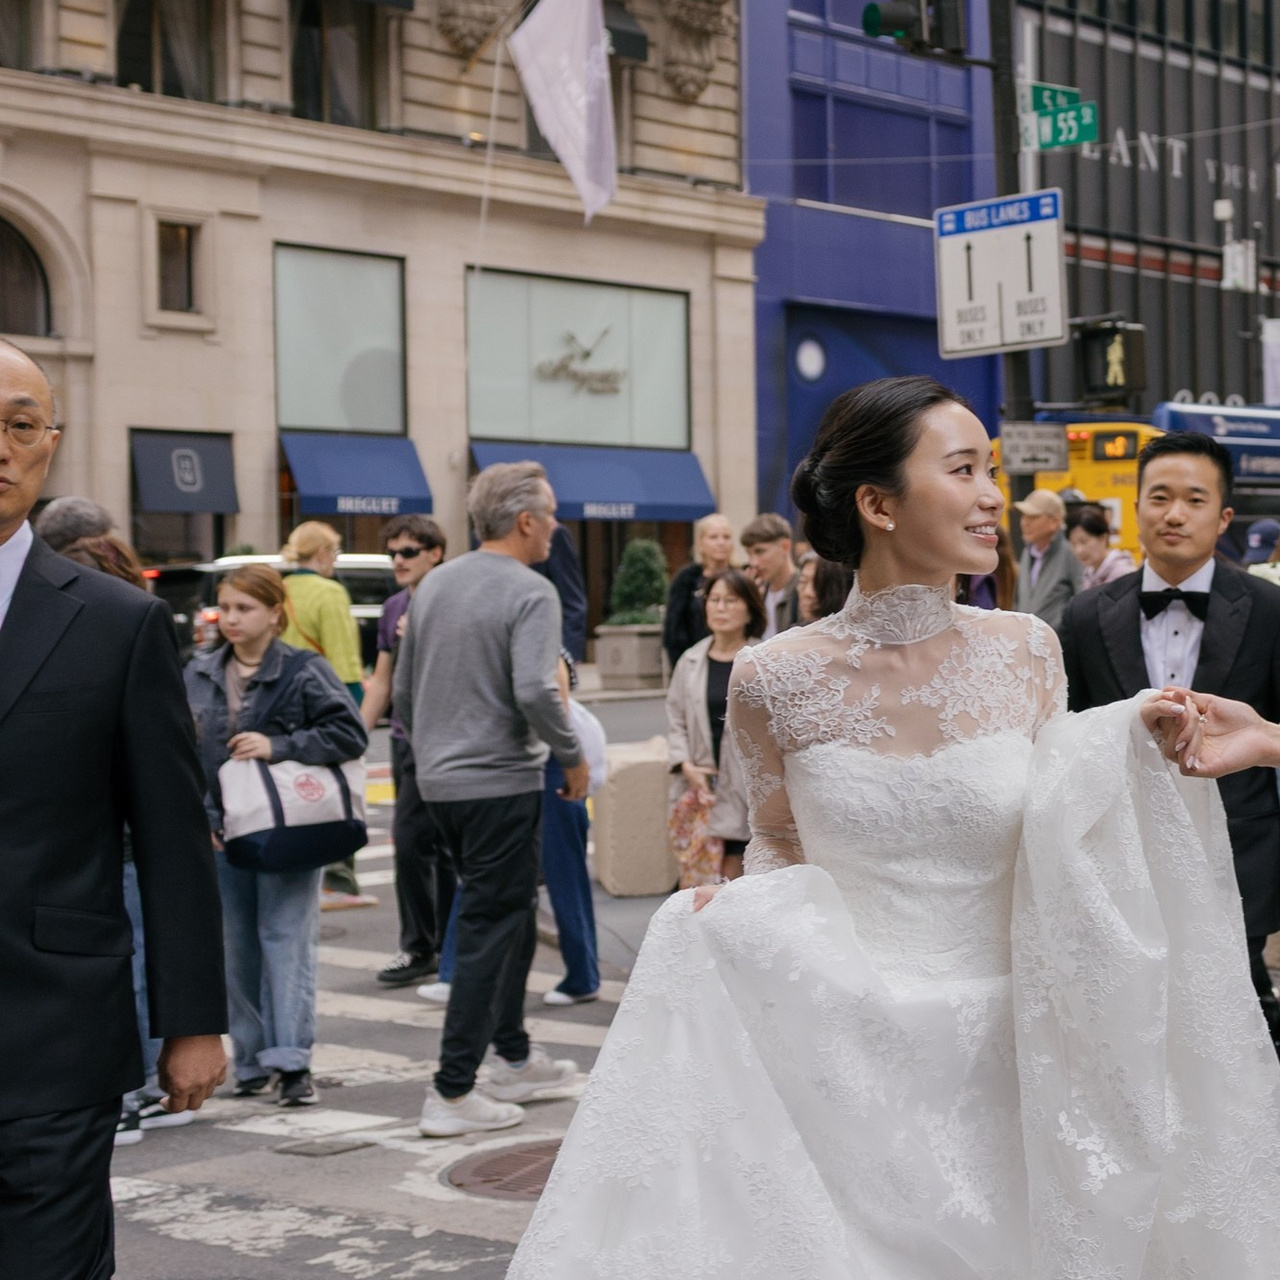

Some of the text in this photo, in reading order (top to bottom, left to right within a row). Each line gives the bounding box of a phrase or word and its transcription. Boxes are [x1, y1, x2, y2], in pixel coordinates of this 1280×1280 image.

[1057, 111, 1079, 142] 55
[964, 201, 1030, 231] BUS LANES
[337, 496, 399, 513] BREGUET
[583, 502, 636, 519] BREGUET
